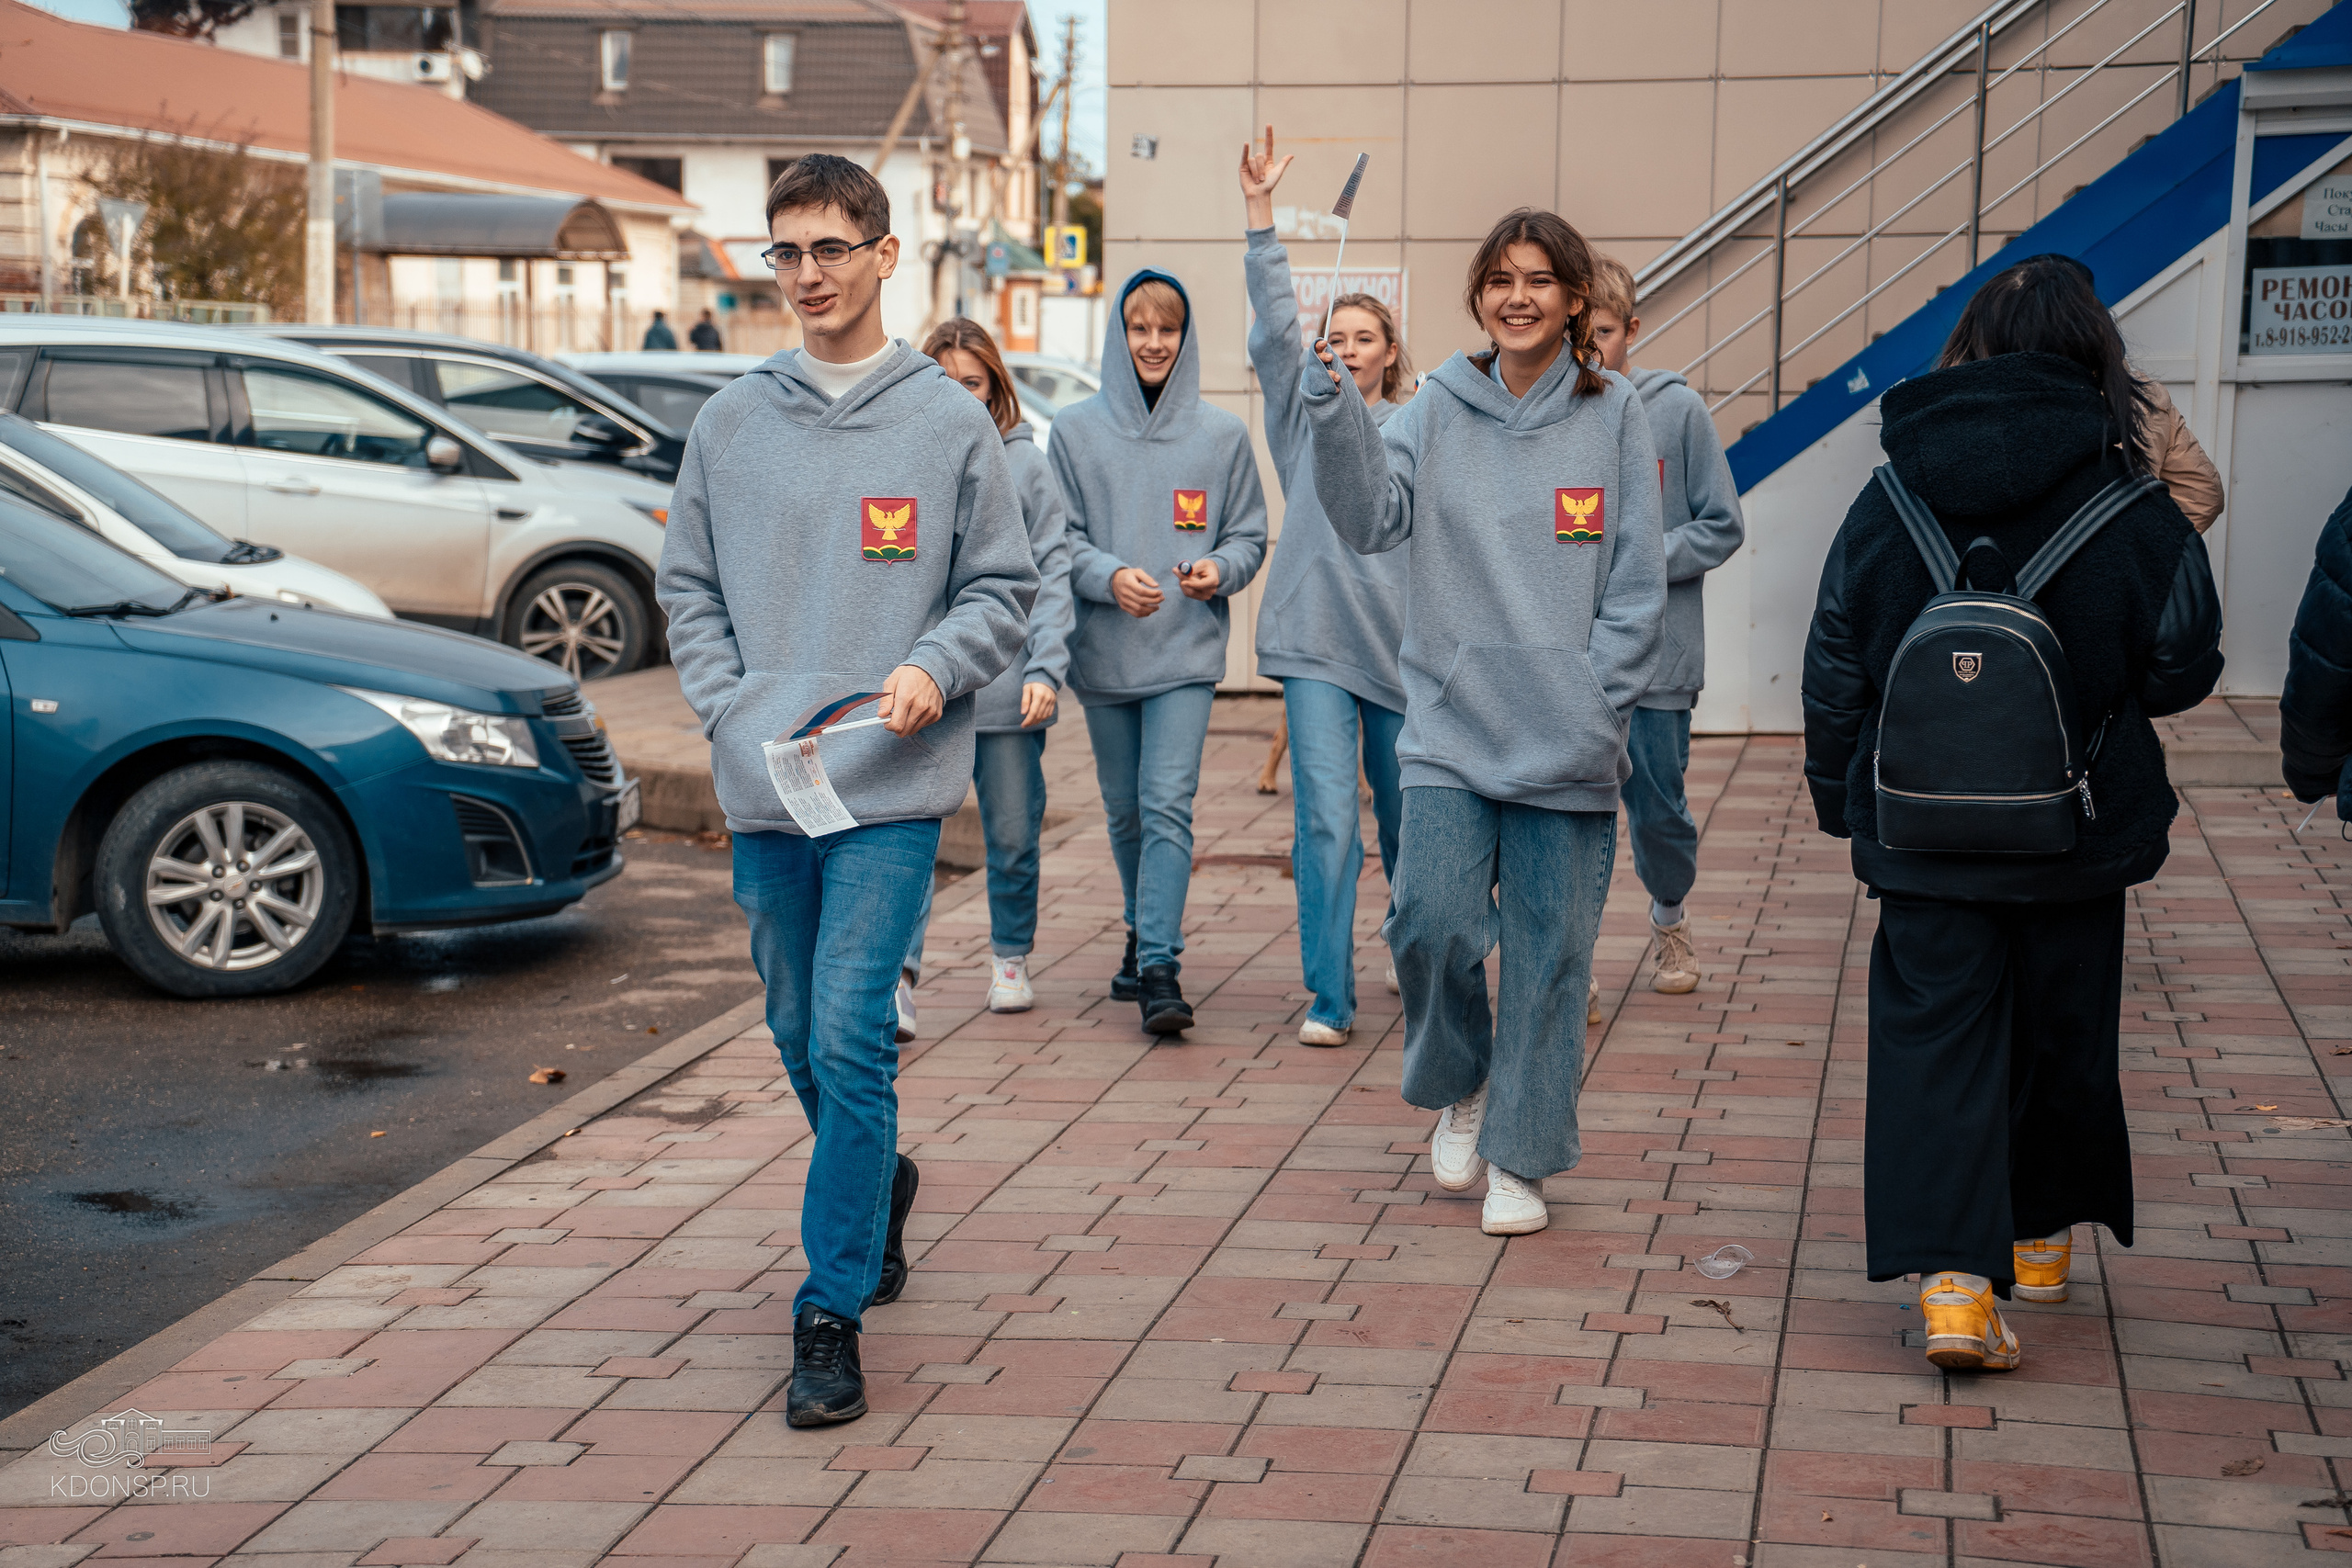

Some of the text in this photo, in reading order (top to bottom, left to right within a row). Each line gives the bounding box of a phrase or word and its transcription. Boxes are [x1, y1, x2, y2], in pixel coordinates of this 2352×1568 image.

[2327, 204, 2352, 218] Ста
[2315, 220, 2348, 232] Часы
[1290, 276, 1398, 306] ТОРОЖНО!
[2274, 299, 2352, 321] ЧАСО
[2256, 323, 2352, 347] т.8-918-952-2
